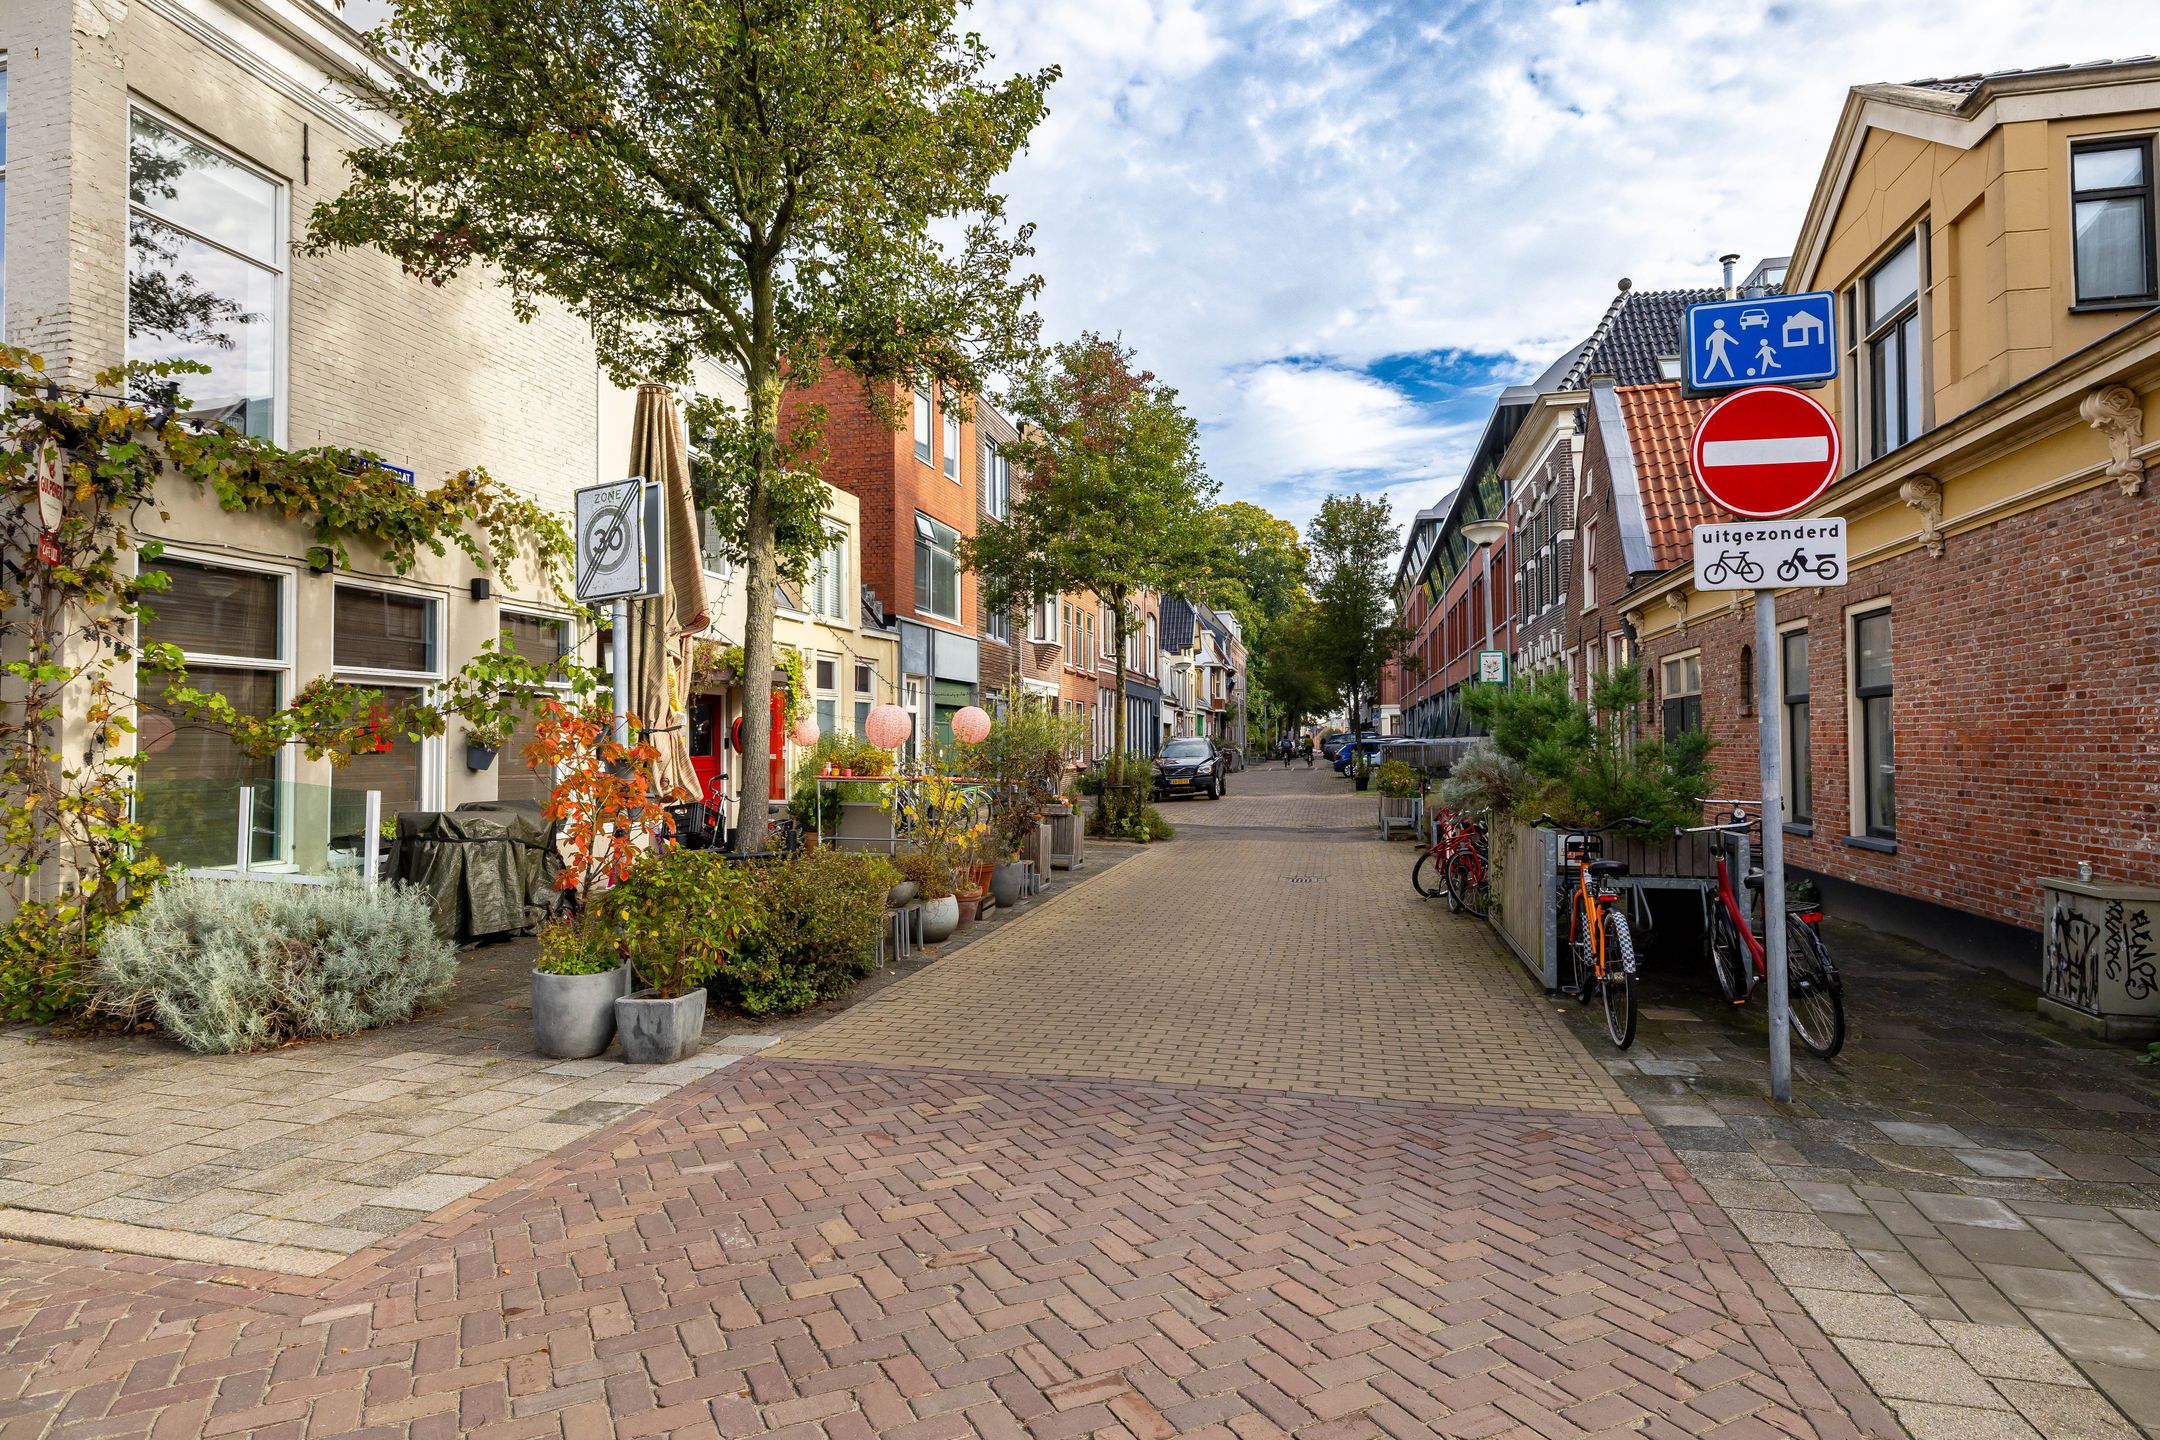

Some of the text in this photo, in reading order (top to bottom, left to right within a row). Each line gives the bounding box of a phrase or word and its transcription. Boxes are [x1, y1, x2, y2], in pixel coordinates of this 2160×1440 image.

[594, 489, 622, 505] ZONE
[592, 526, 624, 554] 30
[1702, 524, 1839, 546] uitgezonderd
